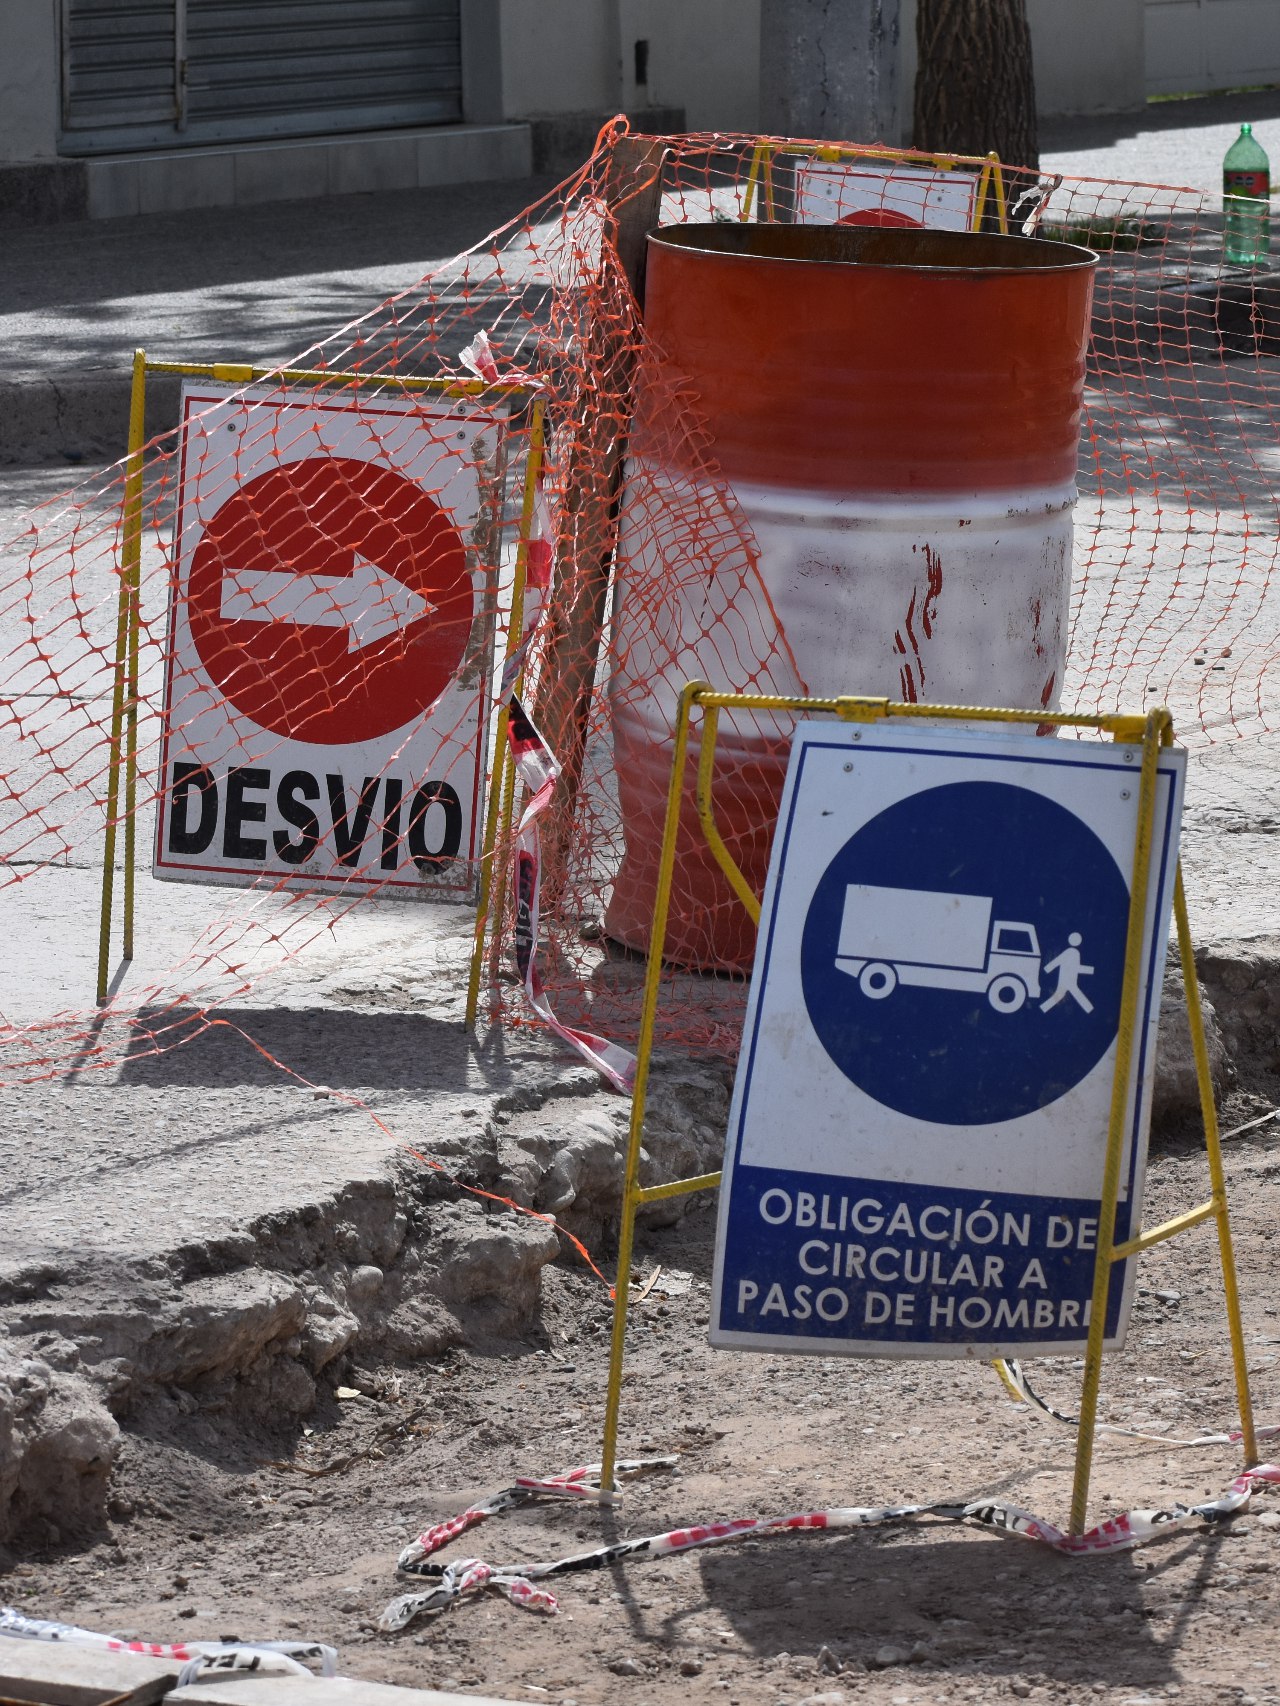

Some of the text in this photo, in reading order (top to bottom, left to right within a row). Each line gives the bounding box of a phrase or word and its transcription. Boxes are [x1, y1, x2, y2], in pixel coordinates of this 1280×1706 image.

[168, 761, 463, 876] DESVIO
[759, 1188, 1098, 1250] OBLIGACIÓN DE
[799, 1239, 1048, 1290] CIRCULAR A
[737, 1280, 849, 1322] PASO
[864, 1291, 916, 1327] DE
